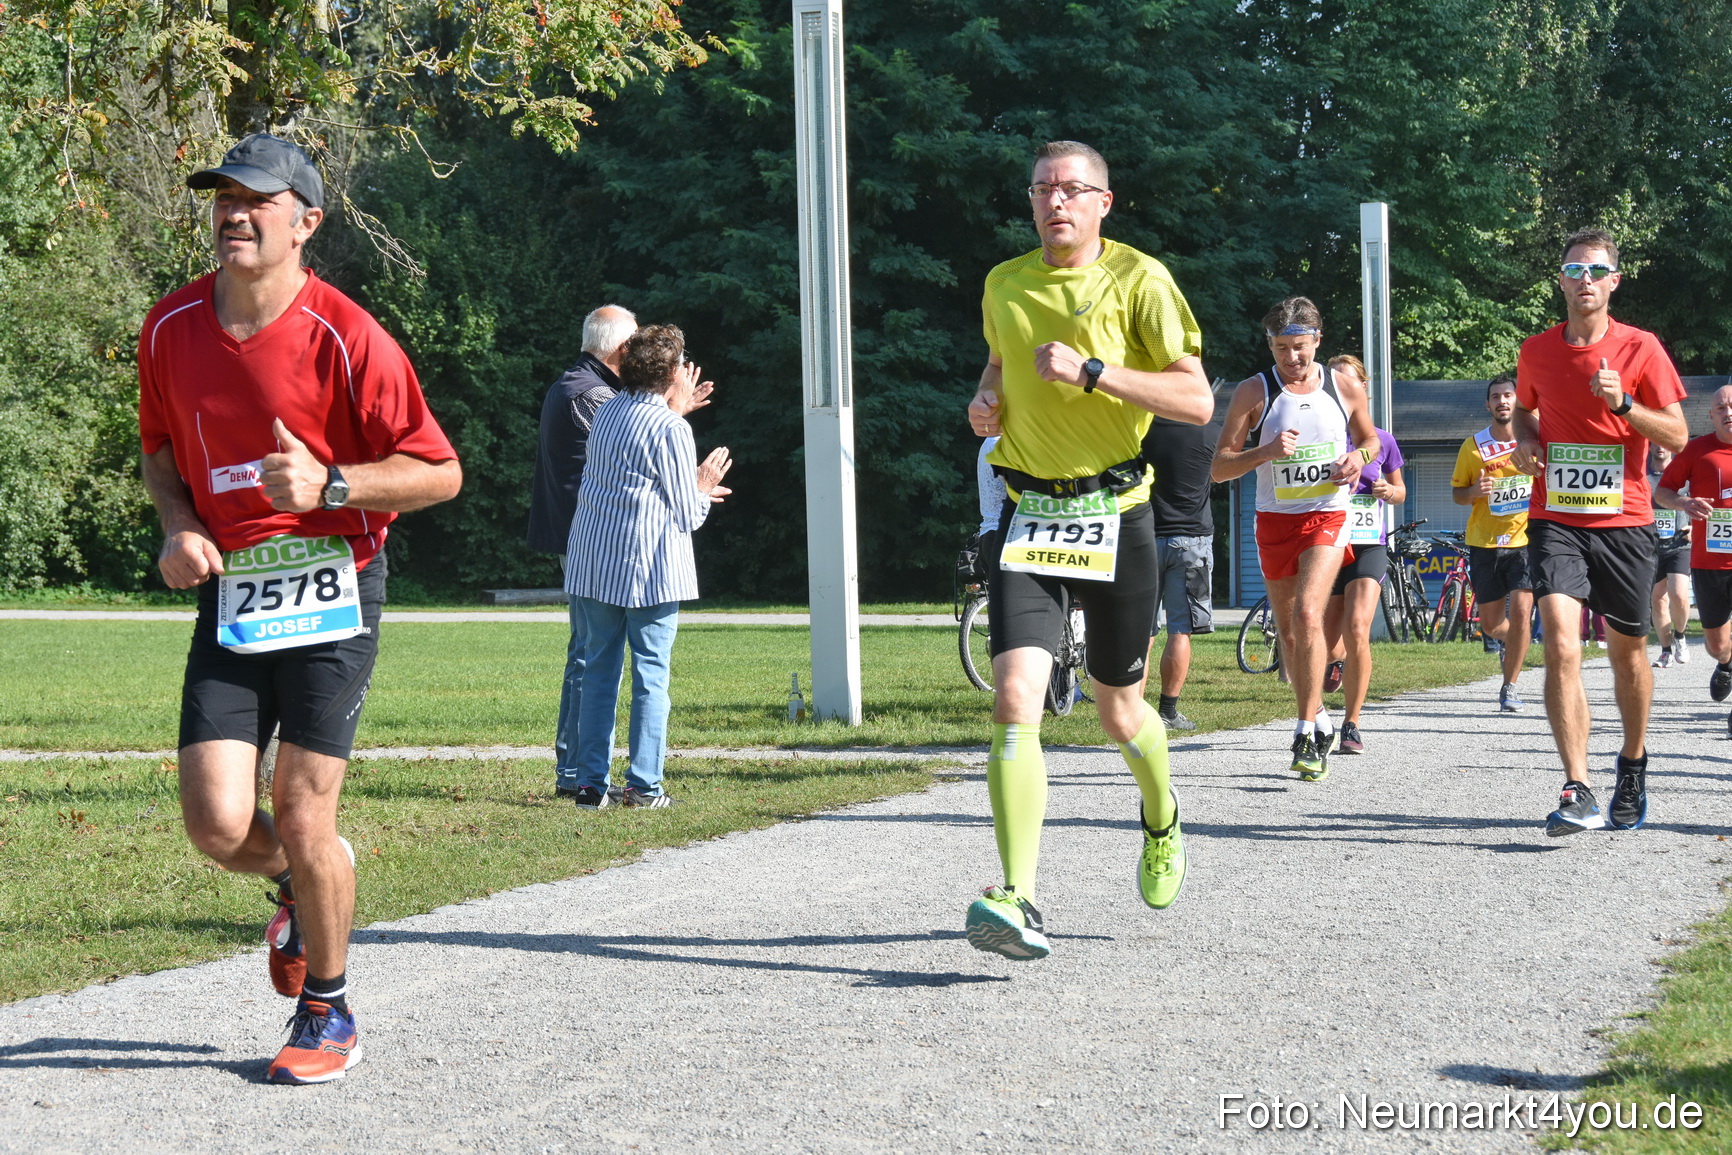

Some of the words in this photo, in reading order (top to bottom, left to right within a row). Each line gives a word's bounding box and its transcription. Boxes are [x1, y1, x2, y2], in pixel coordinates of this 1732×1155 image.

[1279, 445, 1331, 463] OCK
[1552, 445, 1616, 463] BOCK
[230, 468, 257, 483] DEHN
[1281, 463, 1332, 485] 1405
[1493, 474, 1526, 489] BOCK
[1554, 467, 1614, 489] 1204
[1022, 489, 1108, 516] BOCK
[1493, 487, 1527, 503] 2402
[1557, 495, 1608, 505] DOMINIK
[1501, 502, 1522, 512] JOVAN
[1711, 511, 1732, 520] BO
[1354, 512, 1374, 526] 28
[1655, 519, 1671, 529] 95
[1024, 521, 1105, 546] 1193
[1712, 524, 1732, 538] 25
[230, 537, 340, 570] BOCK
[1026, 550, 1090, 567] STEFAN
[236, 567, 341, 616] 2578
[254, 615, 322, 638] JOSEF
